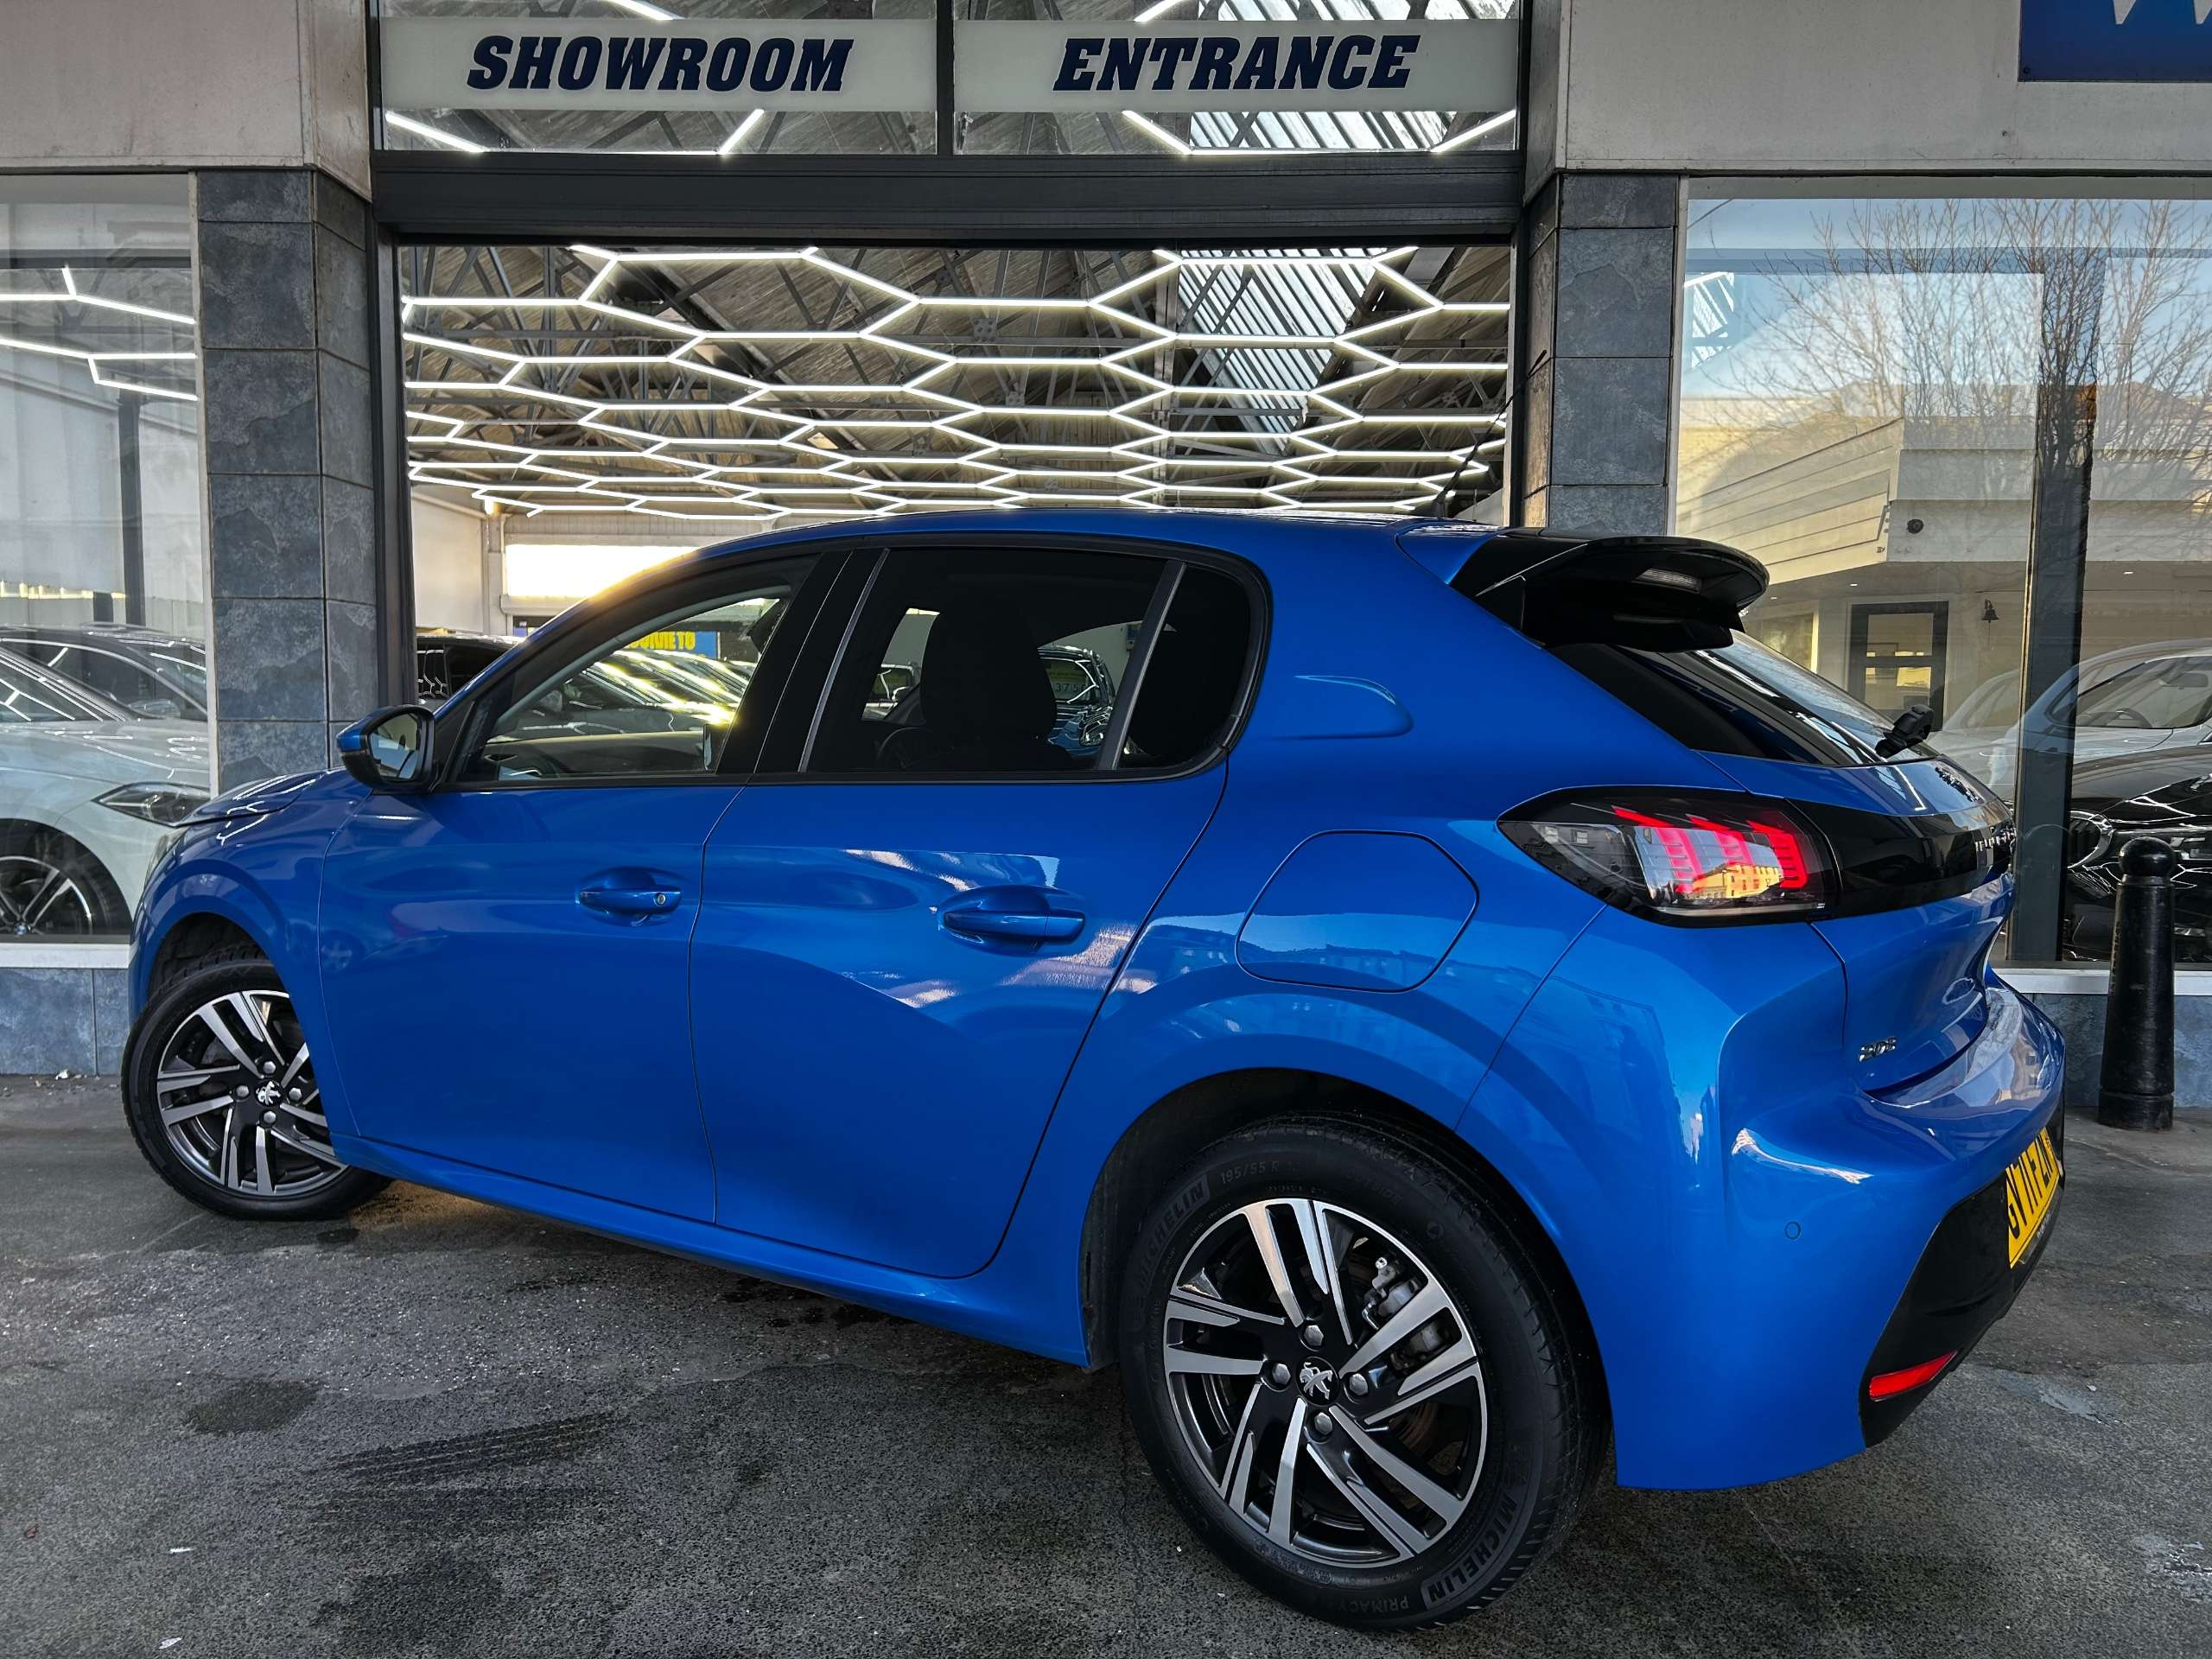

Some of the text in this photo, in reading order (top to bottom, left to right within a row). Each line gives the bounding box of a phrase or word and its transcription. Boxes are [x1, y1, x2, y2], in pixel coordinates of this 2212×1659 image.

[467, 35, 1421, 92] SHOWROOM ENTRANCE
[677, 631, 696, 650] TO
[1219, 1161, 1266, 1185] 195/55
[1427, 1492, 1518, 1602] MICHELIN
